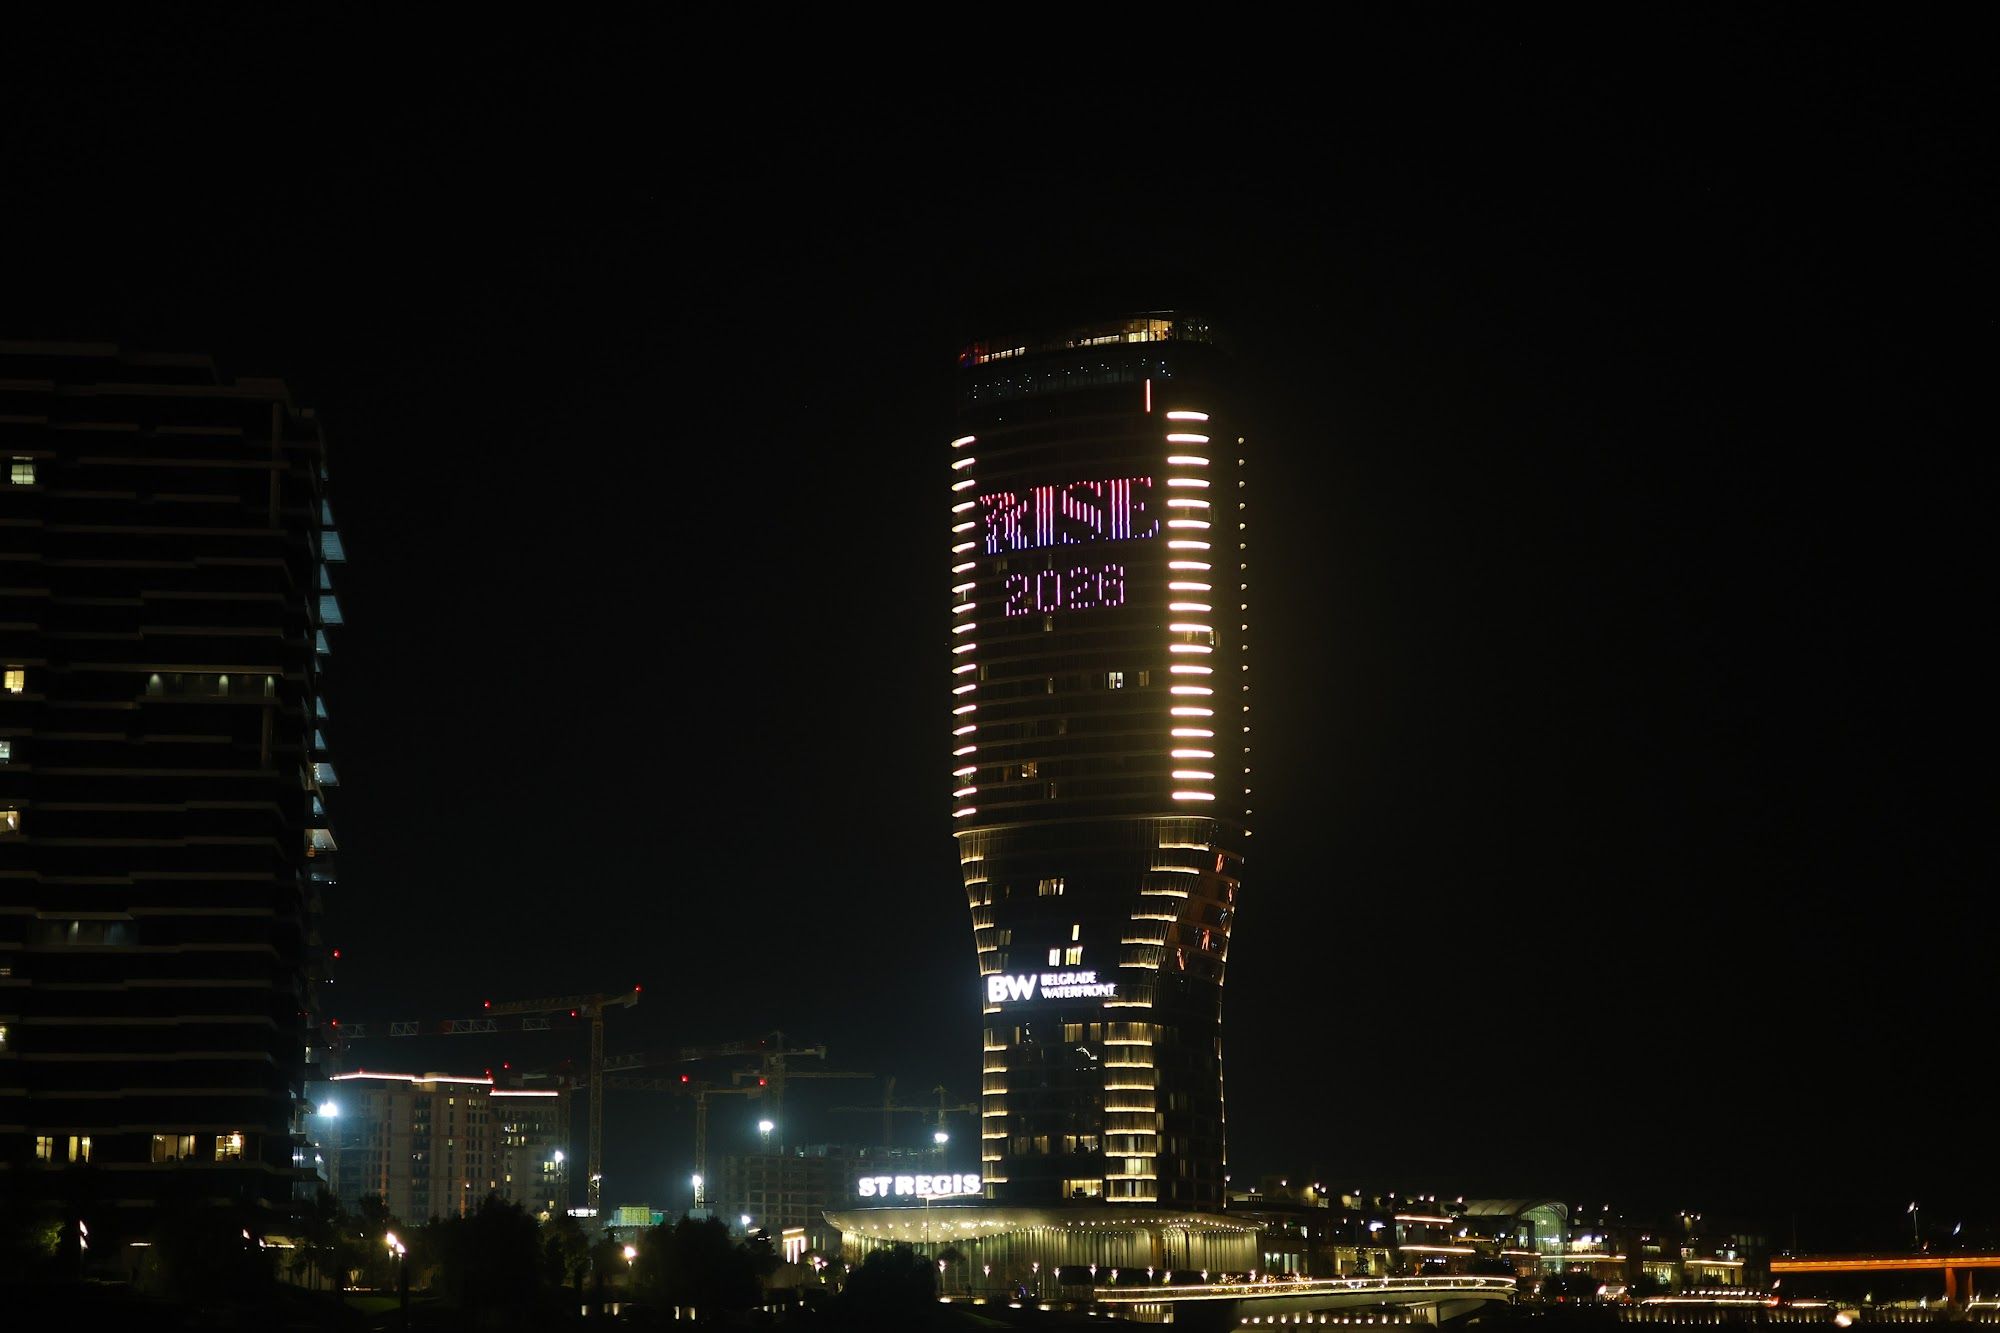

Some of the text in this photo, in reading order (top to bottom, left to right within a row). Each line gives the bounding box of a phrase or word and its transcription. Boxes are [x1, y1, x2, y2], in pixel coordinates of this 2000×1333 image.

[980, 476, 1159, 555] RISE
[1005, 563, 1125, 617] 2026
[987, 973, 1038, 1003] BW
[1040, 970, 1097, 987] BELGRADE
[1040, 983, 1117, 999] WATERFRONT
[858, 1173, 981, 1198] ST REGIS
